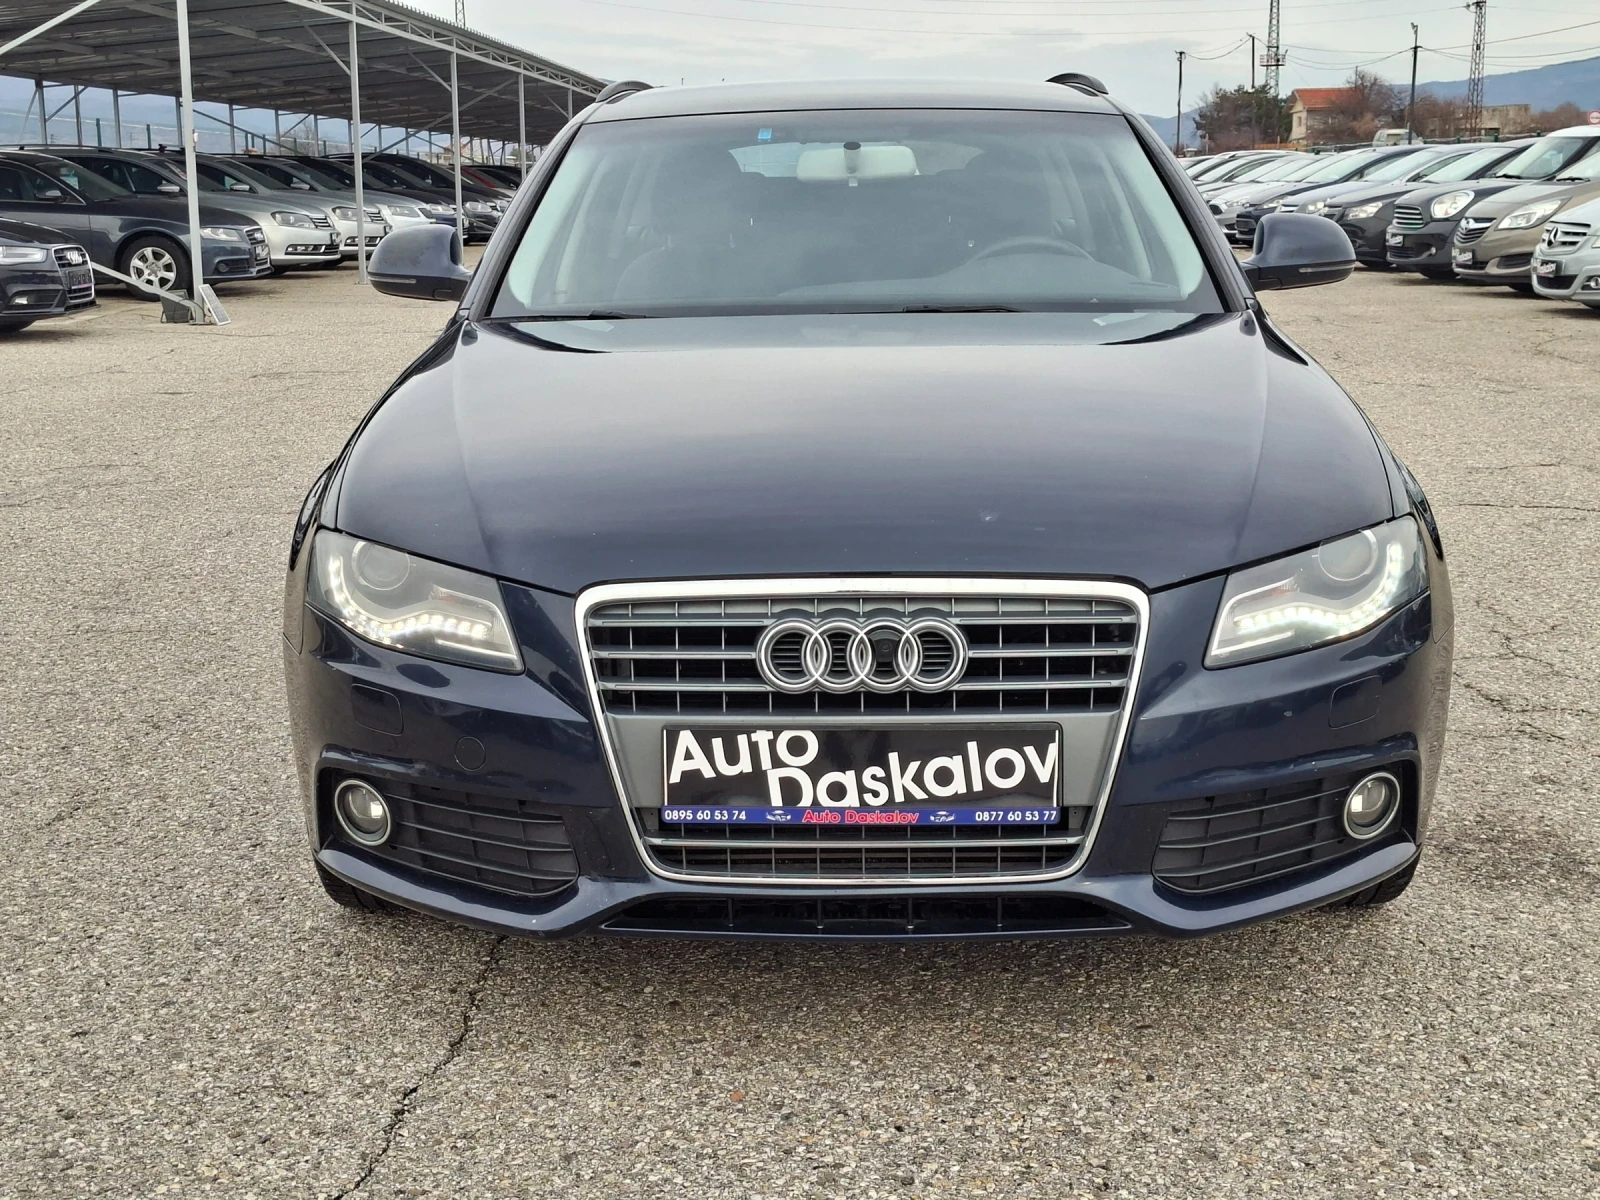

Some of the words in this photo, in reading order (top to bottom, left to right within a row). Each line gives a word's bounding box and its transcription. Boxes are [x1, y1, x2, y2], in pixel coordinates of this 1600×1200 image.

[669, 729, 819, 784] Auto
[766, 741, 1057, 807] Daskalov
[664, 809, 693, 821] 0895
[696, 809, 711, 821] 60
[714, 809, 729, 821] 53
[732, 810, 747, 821] 74
[802, 809, 841, 823] Auto
[845, 809, 920, 824] Daskalov
[975, 811, 1003, 822] 0877
[1007, 811, 1021, 821] 60
[1025, 811, 1039, 821] 53
[1043, 811, 1057, 821] 77
